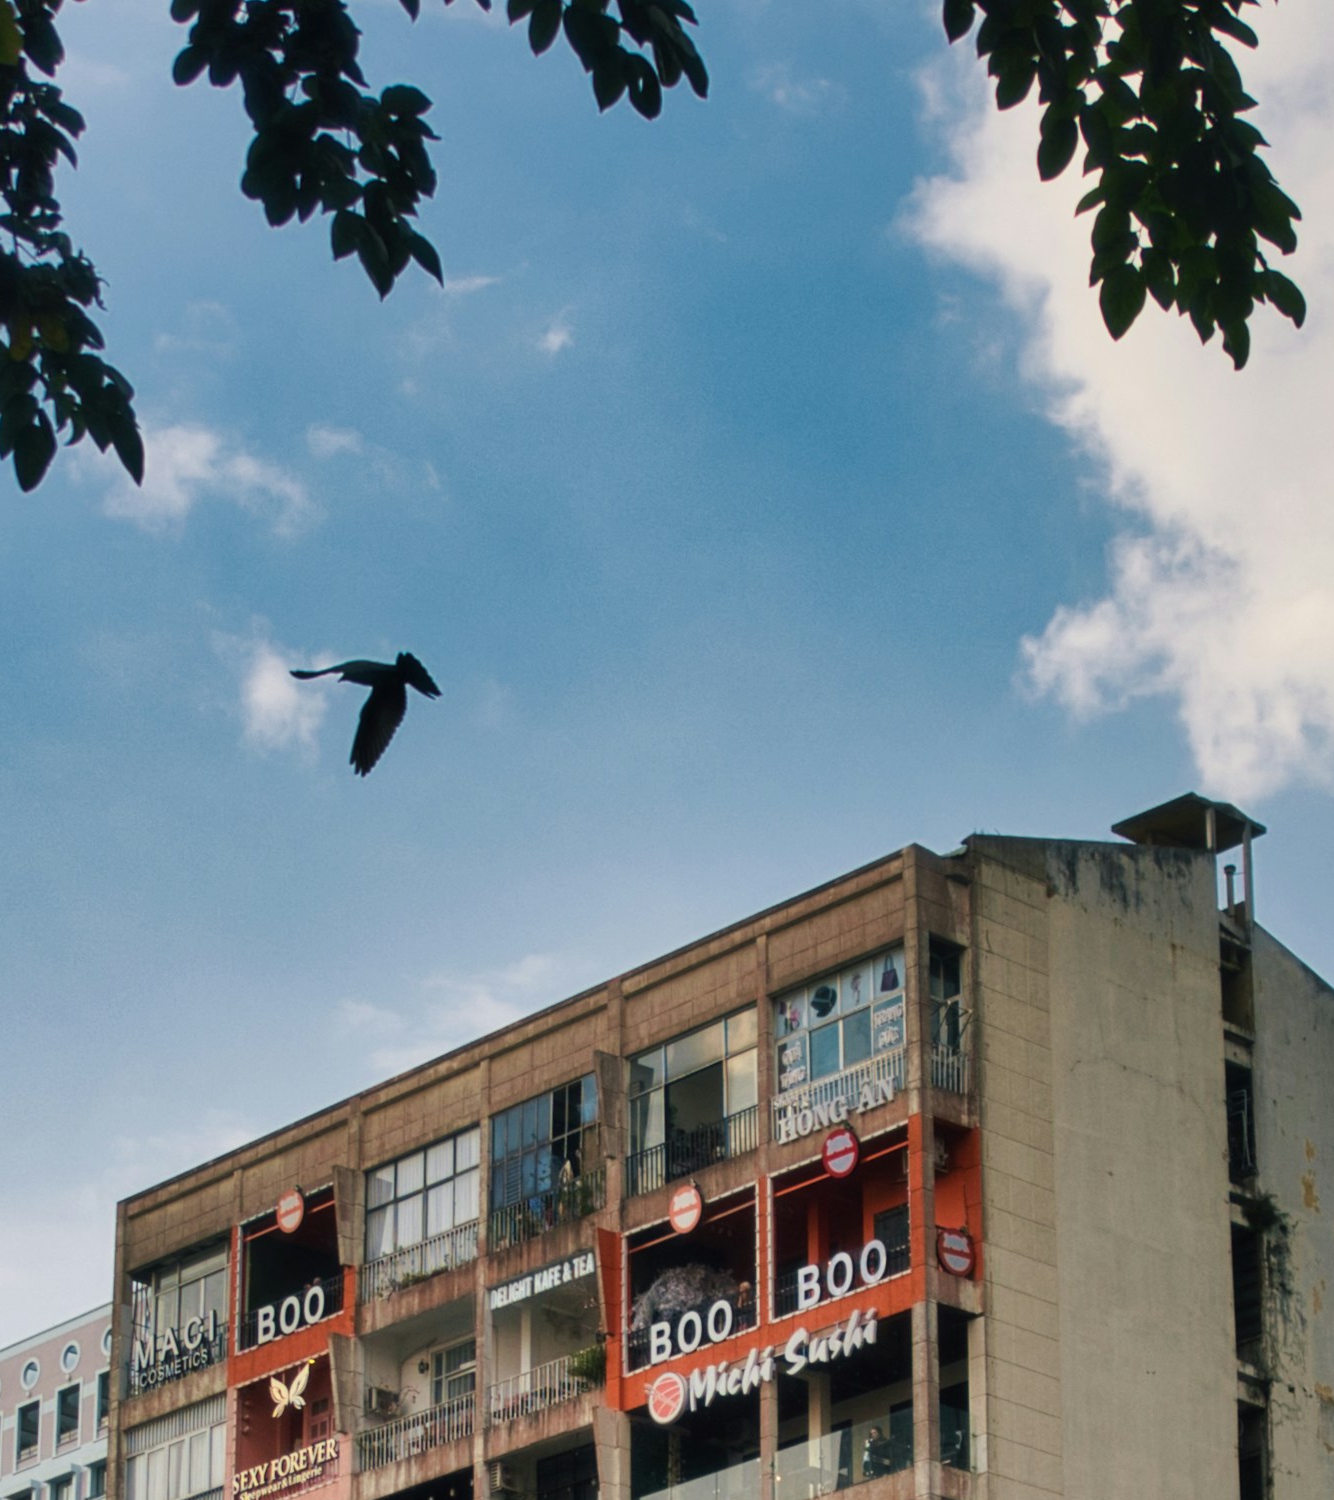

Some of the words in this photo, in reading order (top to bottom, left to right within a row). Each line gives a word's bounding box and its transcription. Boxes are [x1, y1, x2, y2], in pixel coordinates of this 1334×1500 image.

[534, 1265, 562, 1294] KAFE
[573, 1252, 595, 1279] TEA
[798, 1239, 887, 1310] BOO
[257, 1285, 325, 1345] BOO
[650, 1300, 733, 1365] BOO
[139, 1347, 209, 1388] COSMETICS
[689, 1346, 774, 1412] Michi
[784, 1307, 878, 1375] Sushi
[232, 1462, 269, 1496] SEXY
[270, 1438, 339, 1480] FOREVER
